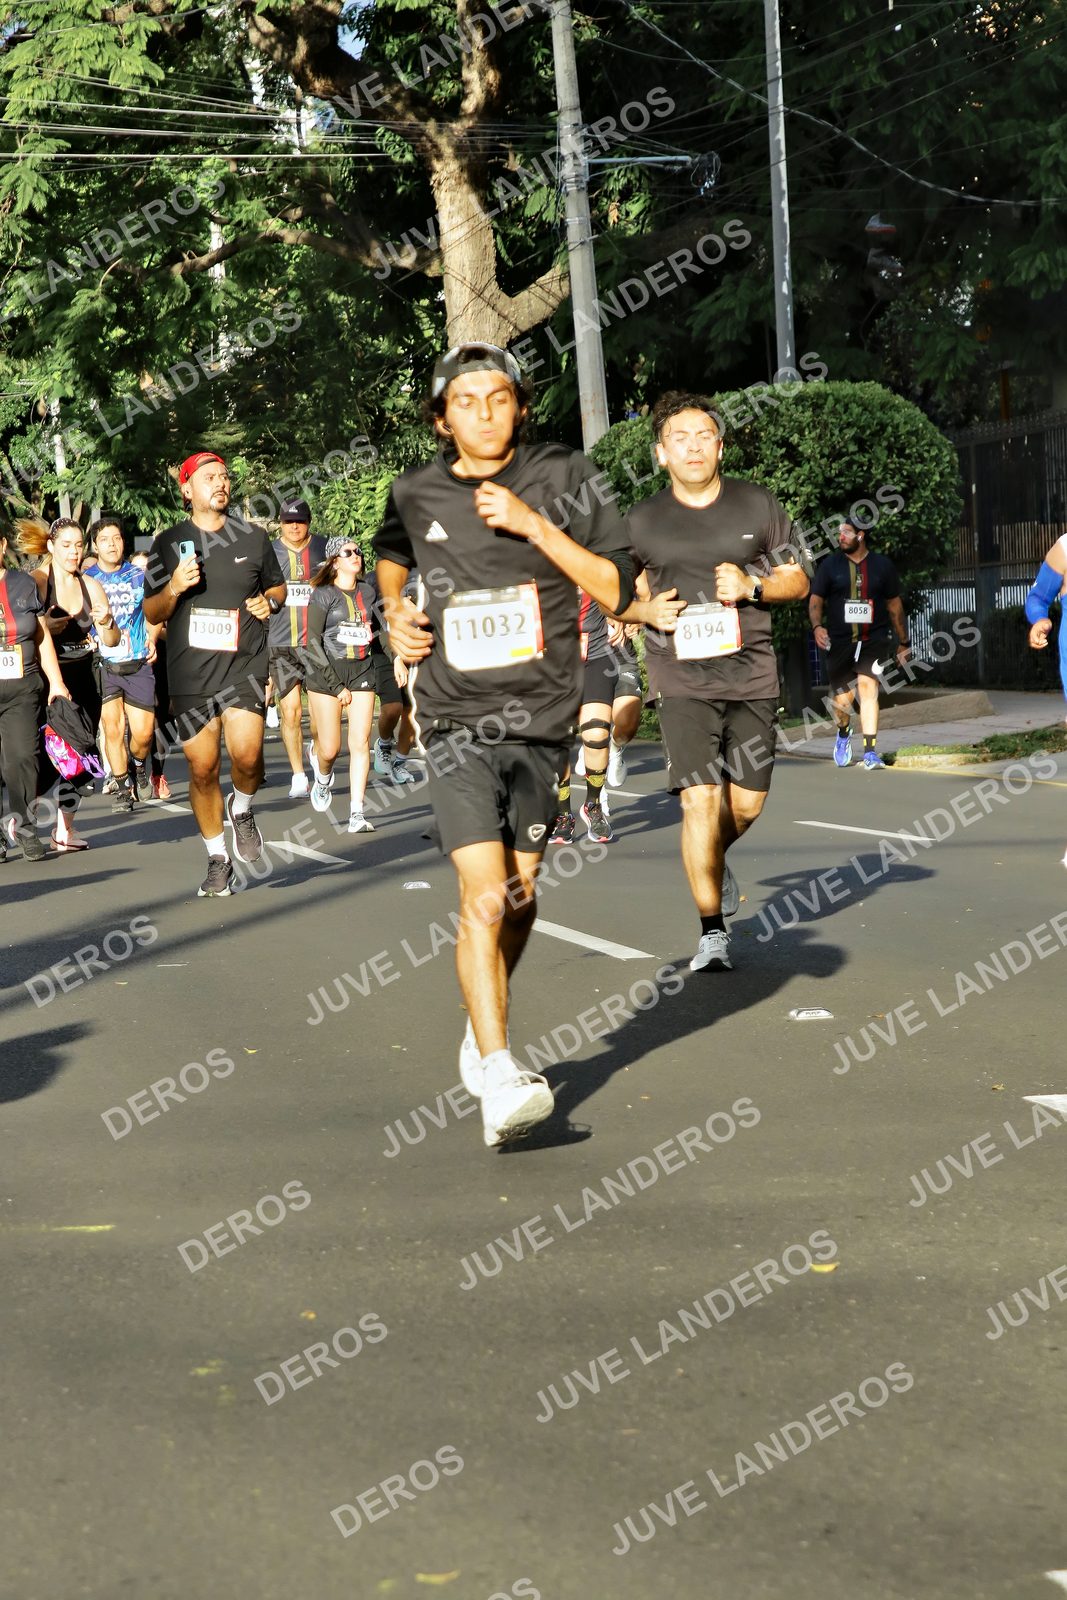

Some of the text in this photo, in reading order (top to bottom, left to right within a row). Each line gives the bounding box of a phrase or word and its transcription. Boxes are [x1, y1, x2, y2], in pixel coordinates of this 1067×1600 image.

[848, 606, 868, 615] 8058
[193, 621, 232, 636] 13009
[451, 613, 527, 641] 11032
[683, 621, 725, 640] 8194
